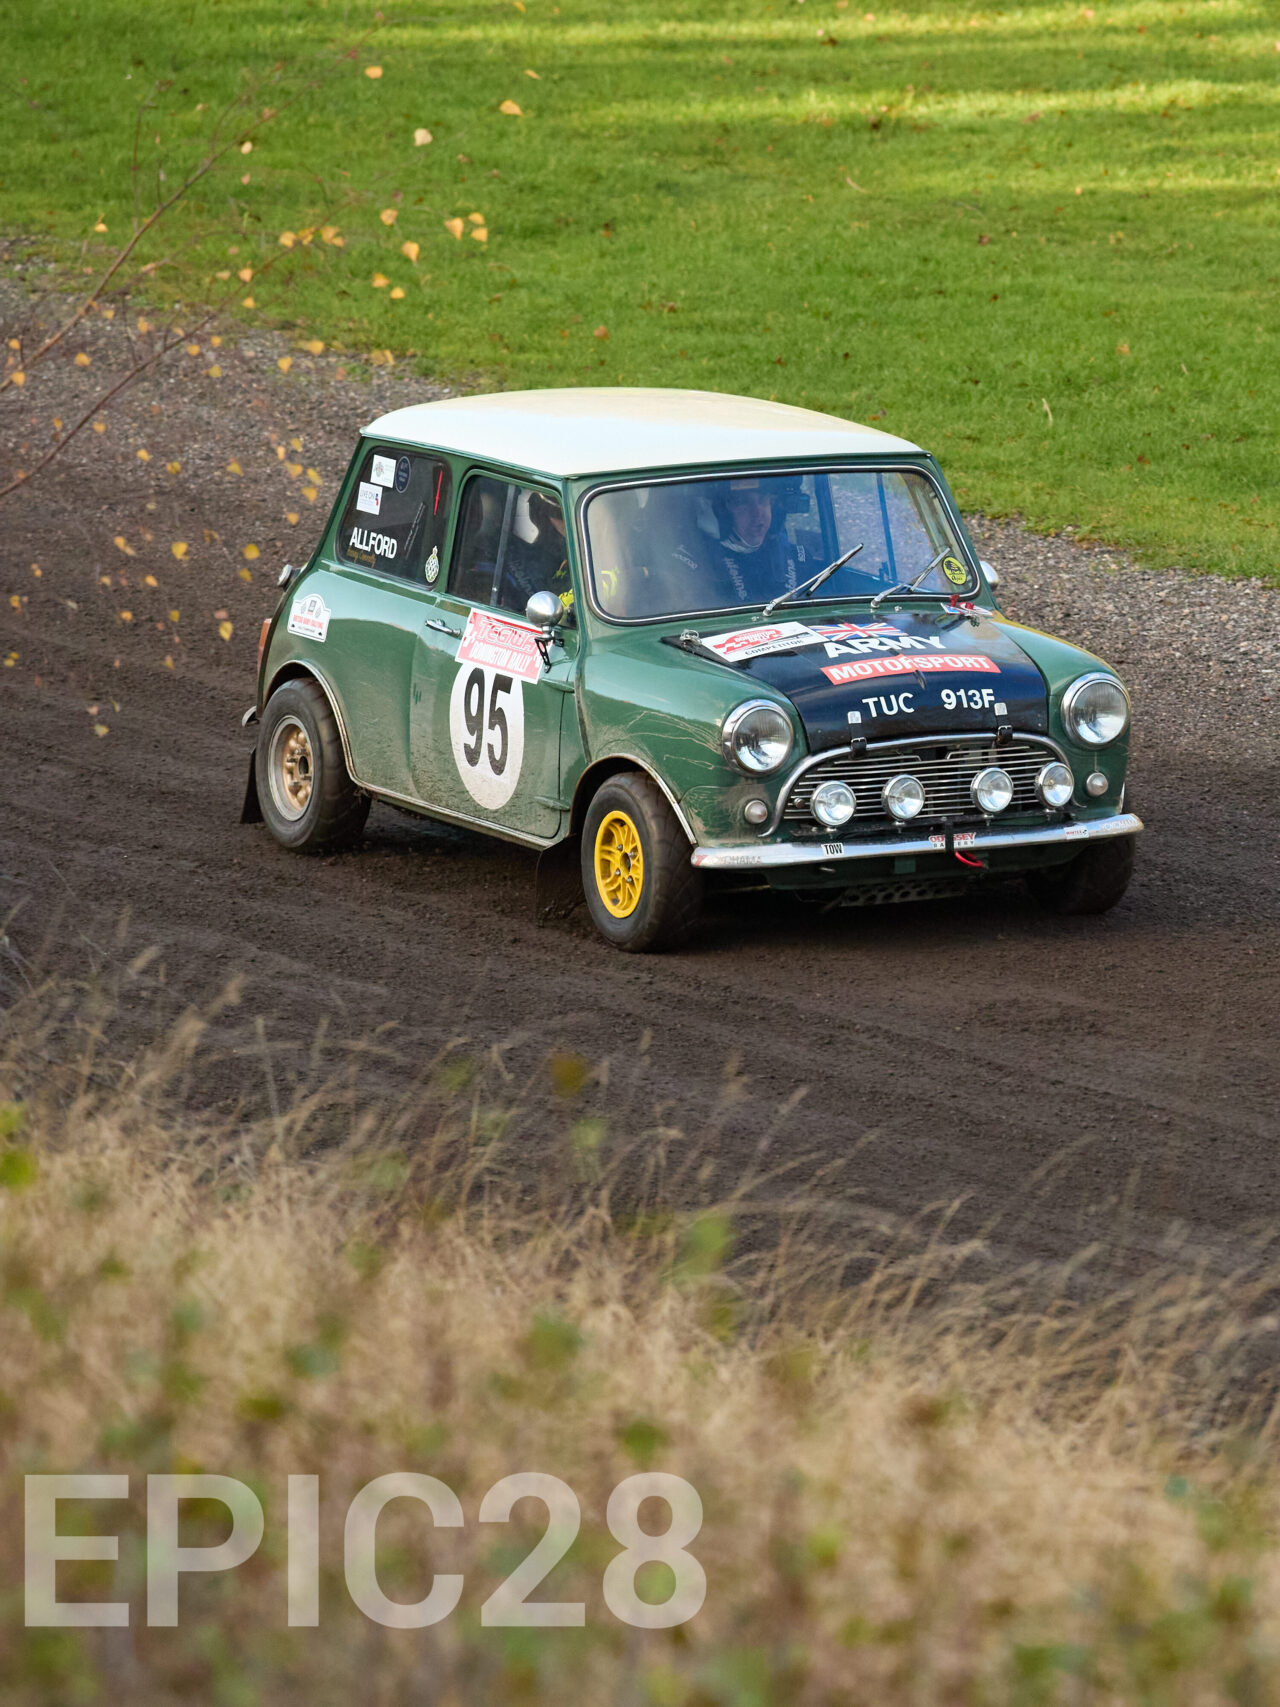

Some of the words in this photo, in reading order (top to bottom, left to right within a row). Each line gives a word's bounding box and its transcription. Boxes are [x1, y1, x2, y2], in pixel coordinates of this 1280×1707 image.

[349, 527, 398, 559] ALLFORD
[469, 640, 513, 668] DONINGTON
[507, 651, 532, 673] RALLY
[744, 639, 804, 656] COMPETITOR
[823, 636, 947, 659] ARMY
[828, 655, 990, 681] MOTORSPORT
[861, 692, 915, 718] TUC
[940, 688, 996, 710] 913F
[463, 667, 514, 776] 95
[824, 844, 844, 855] TOW
